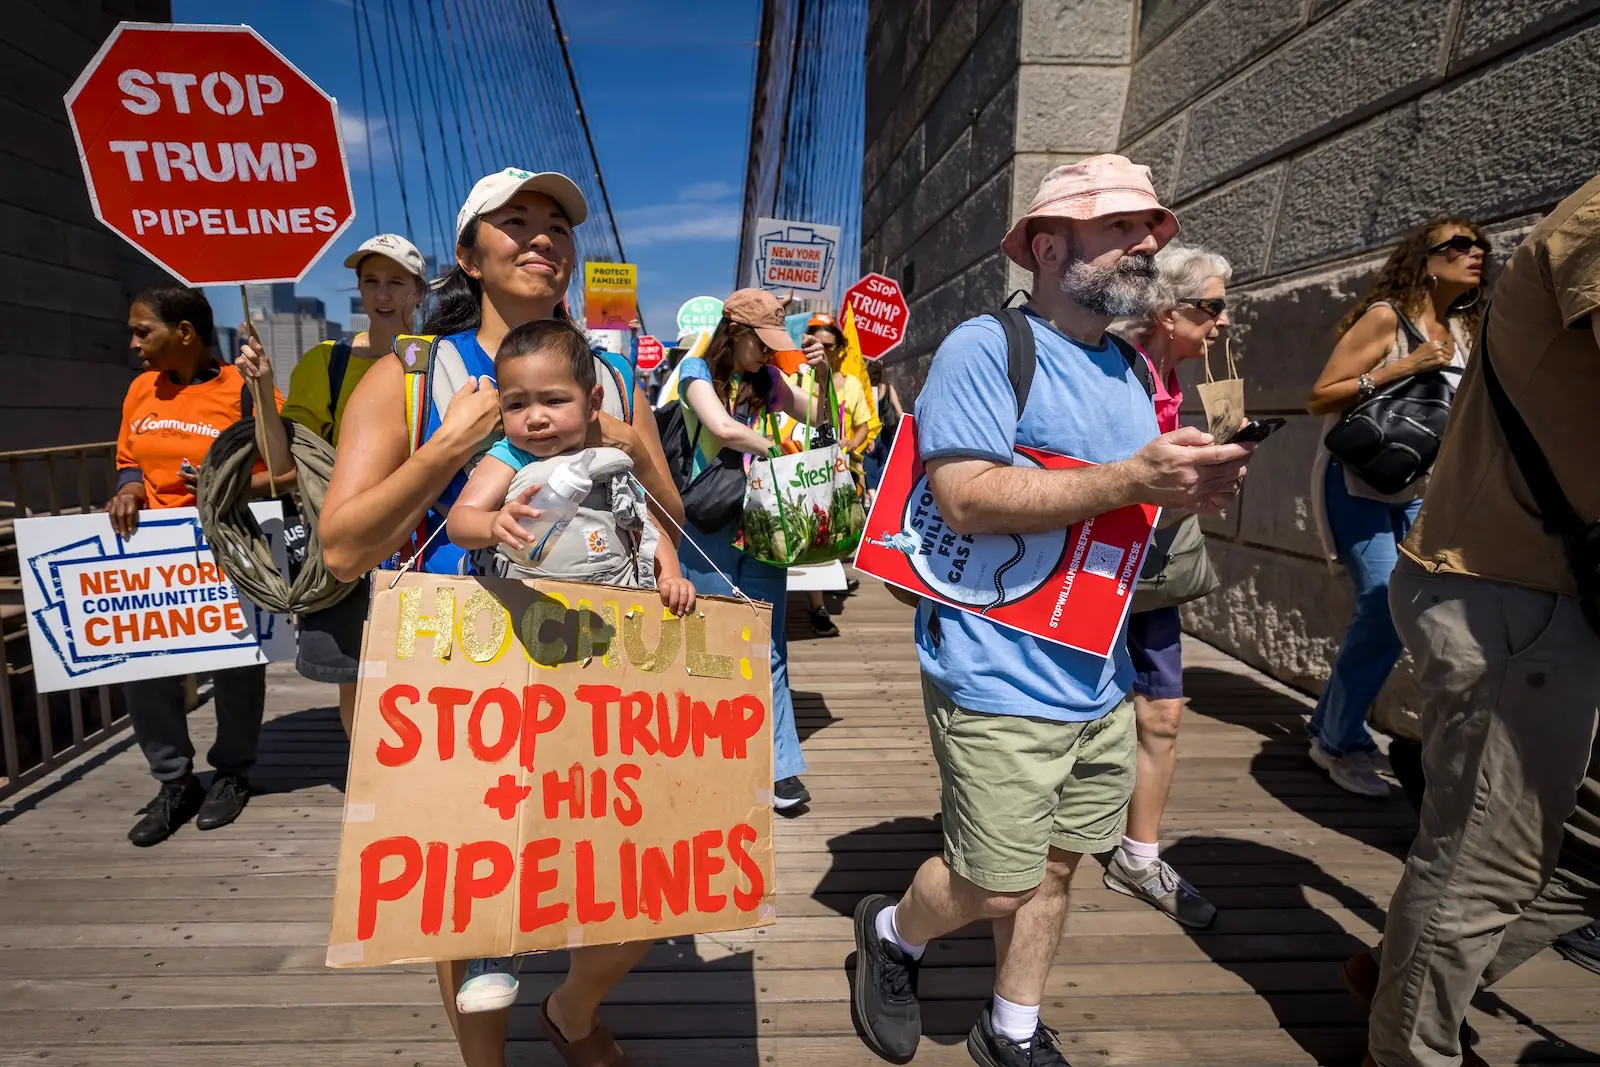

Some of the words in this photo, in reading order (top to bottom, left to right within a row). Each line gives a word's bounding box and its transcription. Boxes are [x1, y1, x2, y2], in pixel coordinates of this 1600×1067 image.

[117, 68, 284, 116] STOP
[108, 140, 318, 183] TRUMP
[132, 206, 338, 236] PIPELINES
[771, 246, 795, 259] NEW
[797, 248, 821, 260] YORK
[594, 268, 629, 276] PROTECT
[768, 266, 819, 283] CHANGE
[866, 279, 897, 297] STOP
[692, 302, 714, 312] GO
[852, 291, 901, 322] TRUMP
[79, 566, 151, 596] NEW
[948, 545, 970, 583] GAS
[1049, 516, 1096, 628] STOPWILLIAMSNESEPIPE
[1116, 541, 1142, 596] #STOPNESE
[82, 585, 229, 614] COMMUNITIES
[84, 602, 243, 647] CHANGE
[375, 683, 566, 772] STOP
[574, 684, 765, 759] TRUMP
[542, 762, 643, 826] HIS
[357, 823, 765, 941] PIPELINES
